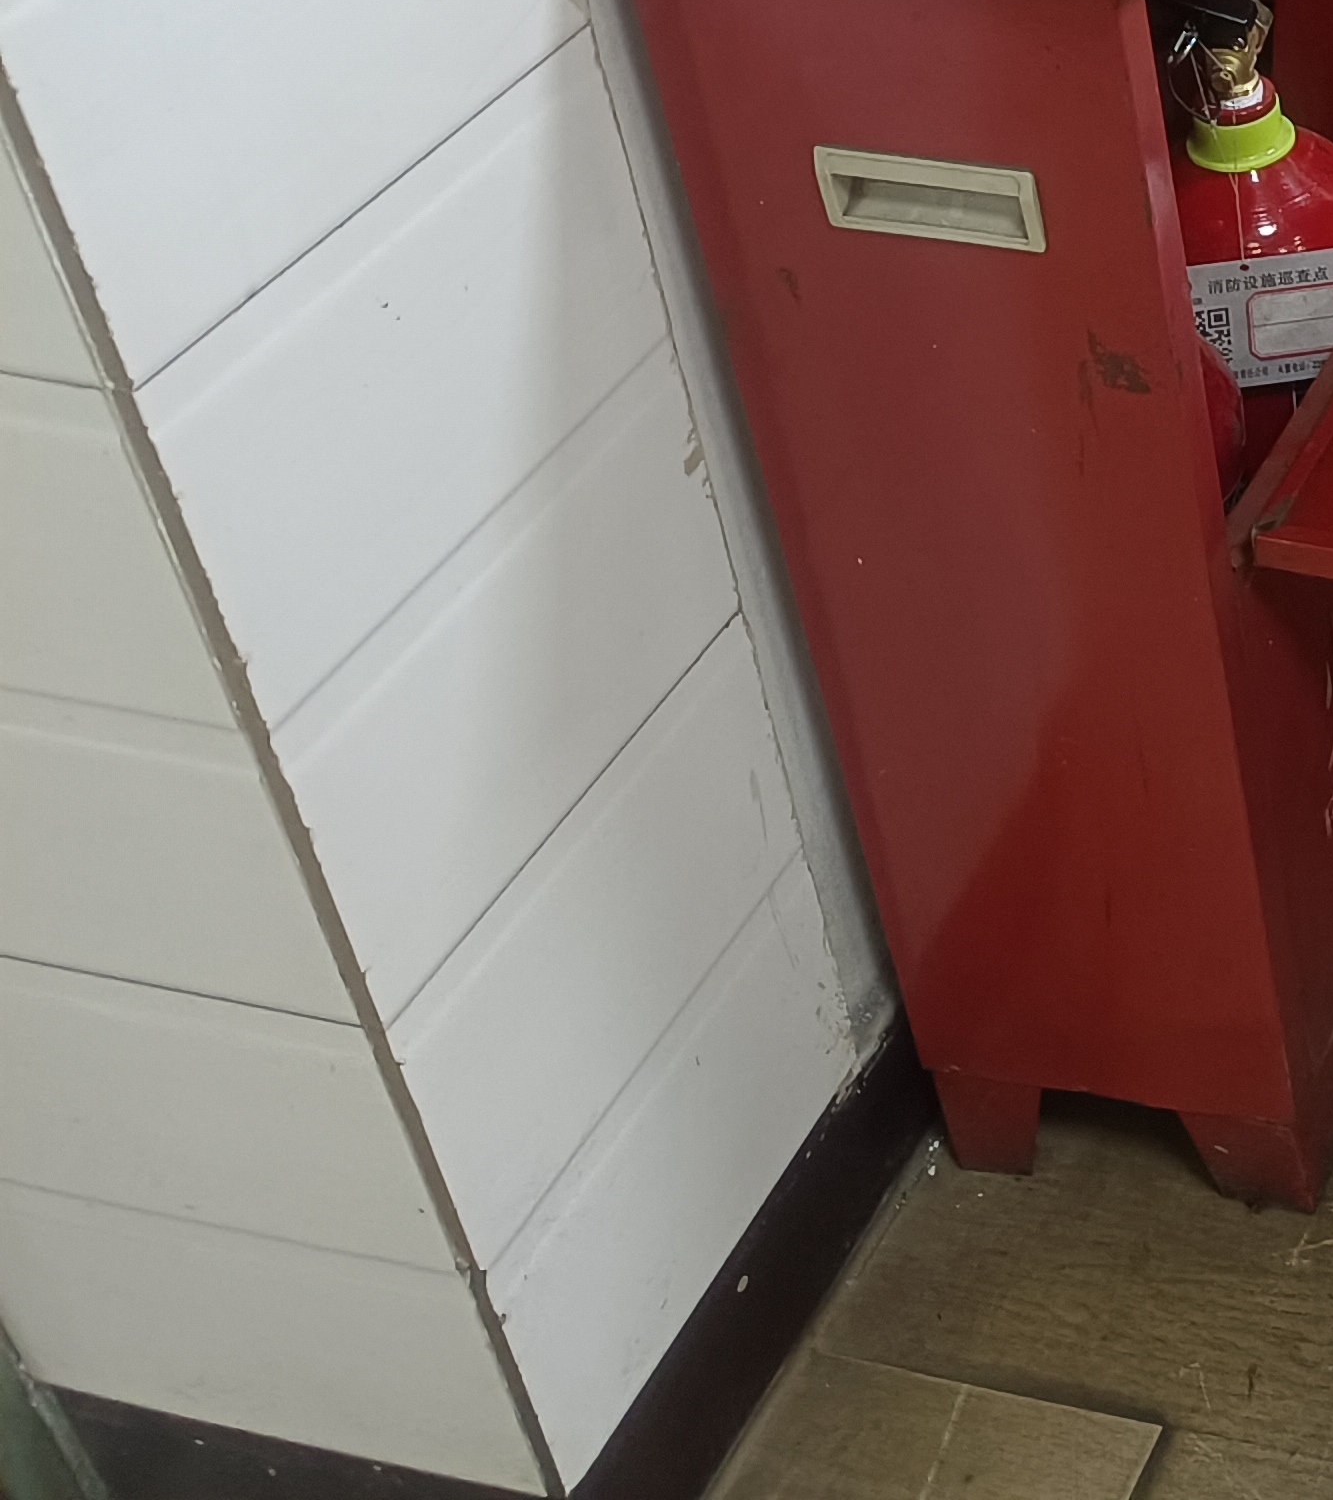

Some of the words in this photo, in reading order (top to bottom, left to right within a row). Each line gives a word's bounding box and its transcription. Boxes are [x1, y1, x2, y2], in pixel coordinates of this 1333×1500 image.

[1208, 266, 1329, 296] 消防设施巡查点
